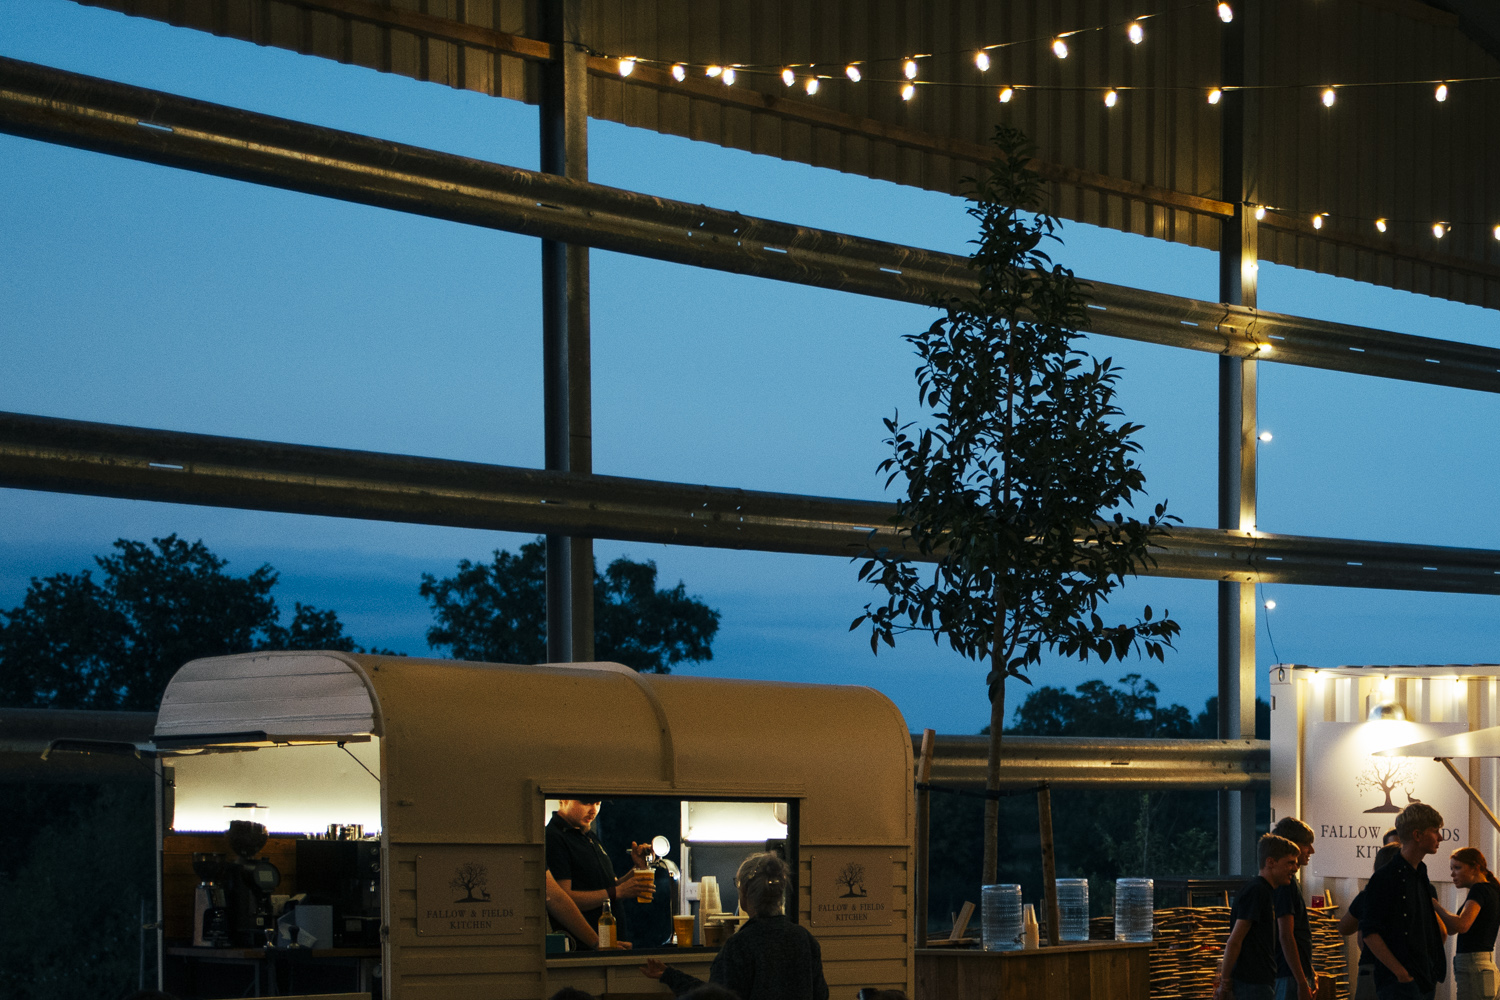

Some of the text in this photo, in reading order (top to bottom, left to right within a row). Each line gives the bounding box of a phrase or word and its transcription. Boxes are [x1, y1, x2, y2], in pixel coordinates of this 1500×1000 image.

[1321, 824, 1381, 839] FALLOW
[818, 904, 848, 912] FALLOW
[860, 903, 885, 911] FIELDS
[427, 909, 514, 918] FALLOW & FIELDS
[450, 921, 492, 929] KITCHEN
